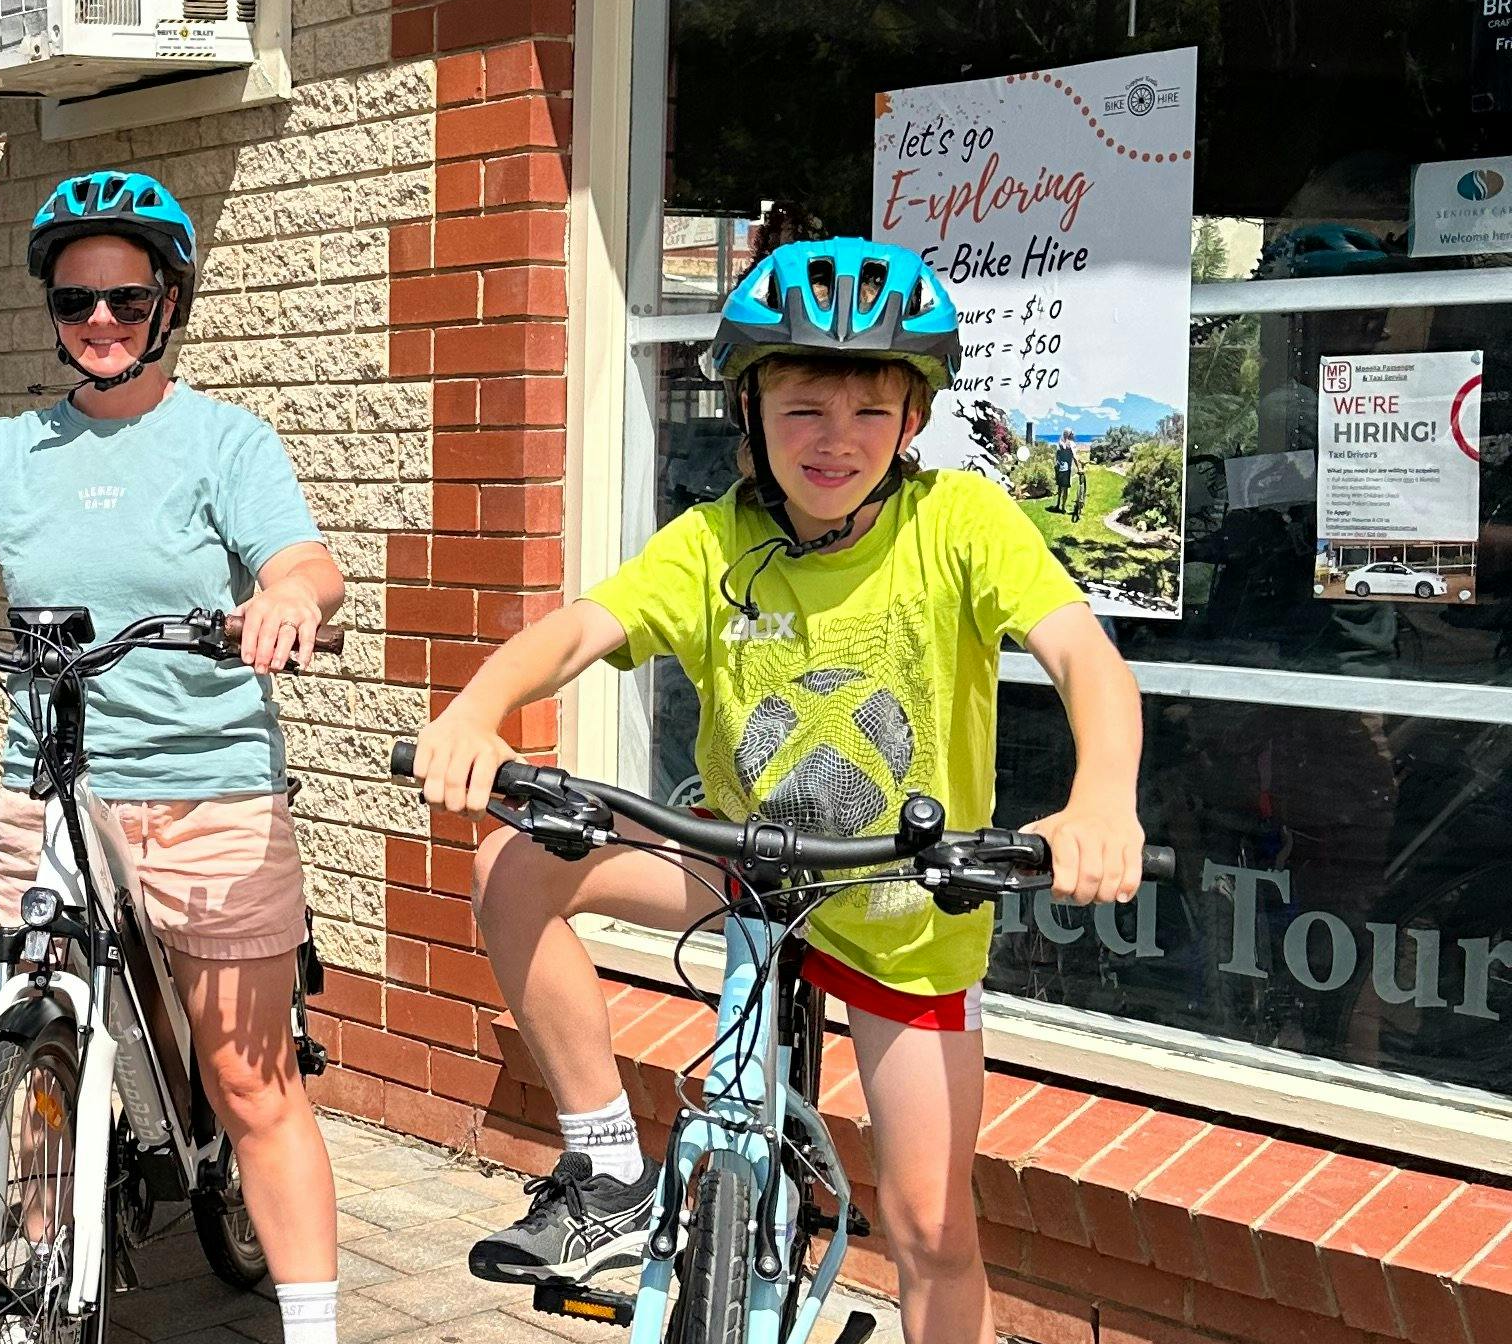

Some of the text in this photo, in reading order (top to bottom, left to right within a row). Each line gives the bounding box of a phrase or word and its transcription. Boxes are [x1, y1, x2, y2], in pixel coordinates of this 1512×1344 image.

[1104, 92, 1180, 112] BIKE HIRE
[899, 117, 994, 163] let's go
[882, 152, 1095, 242] E-xploring
[1439, 232, 1489, 244] Welcome
[1021, 235, 1089, 279] Hire
[1334, 395, 1400, 415] WE'RE
[1334, 421, 1437, 443] HIRING!
[1328, 450, 1378, 459] Taxi Drivers
[1202, 857, 1512, 1021] Tour
